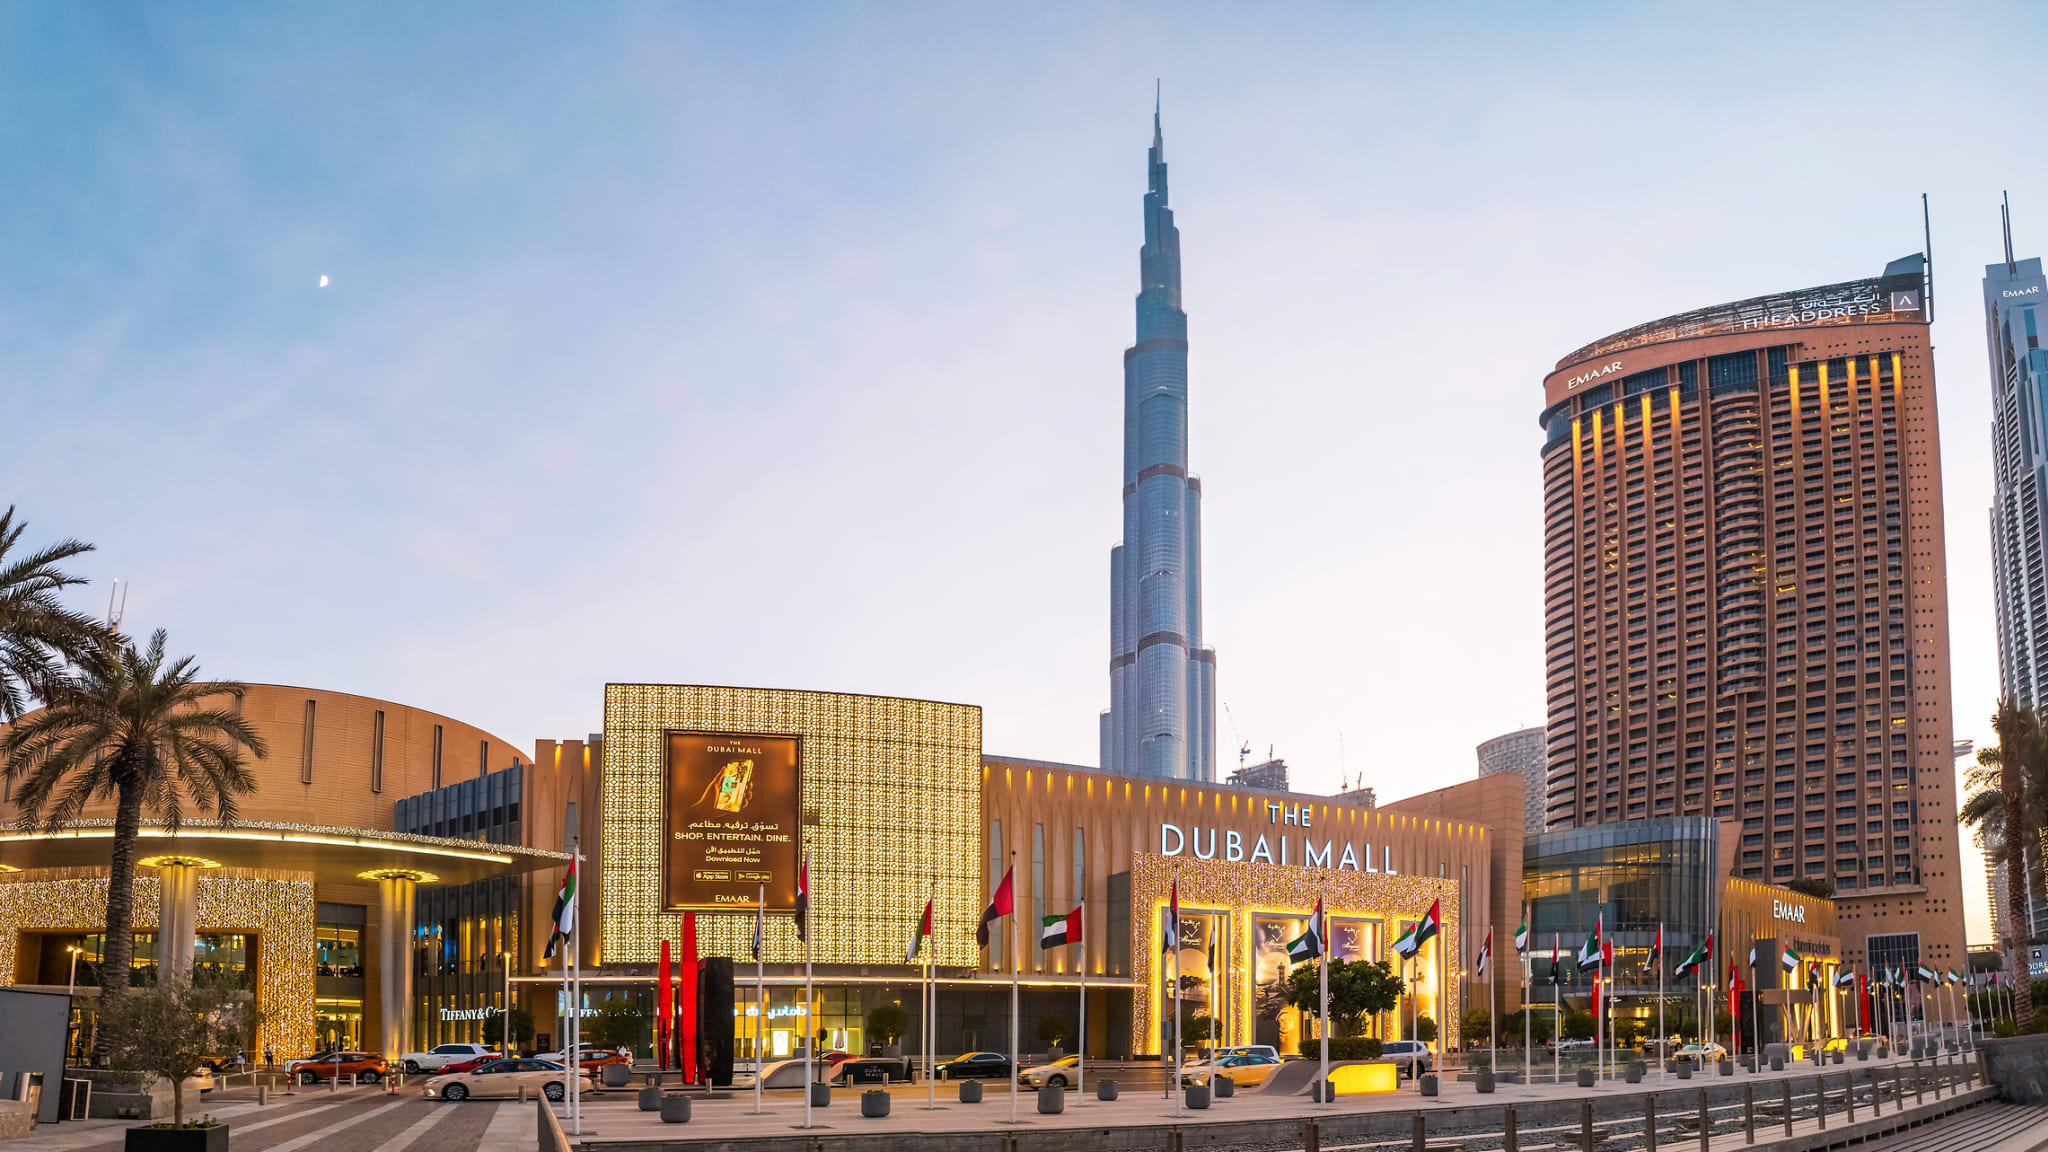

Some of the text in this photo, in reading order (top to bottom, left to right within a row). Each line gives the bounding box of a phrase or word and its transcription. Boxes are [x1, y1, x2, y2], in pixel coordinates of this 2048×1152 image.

[2003, 286, 2040, 297] EMAAR
[1741, 303, 1880, 330] THE ADDRESS
[1568, 361, 1623, 390] EMAAR
[707, 745, 735, 753] DUBAI
[1268, 804, 1311, 827] THE
[674, 832, 792, 843] SHOP. ENTERTAIN. DINE.
[1161, 823, 1397, 875] DUBAI MALL
[705, 855, 761, 864] Download Now
[715, 894, 750, 903] EMAAR
[1773, 899, 1806, 924] EMAAR
